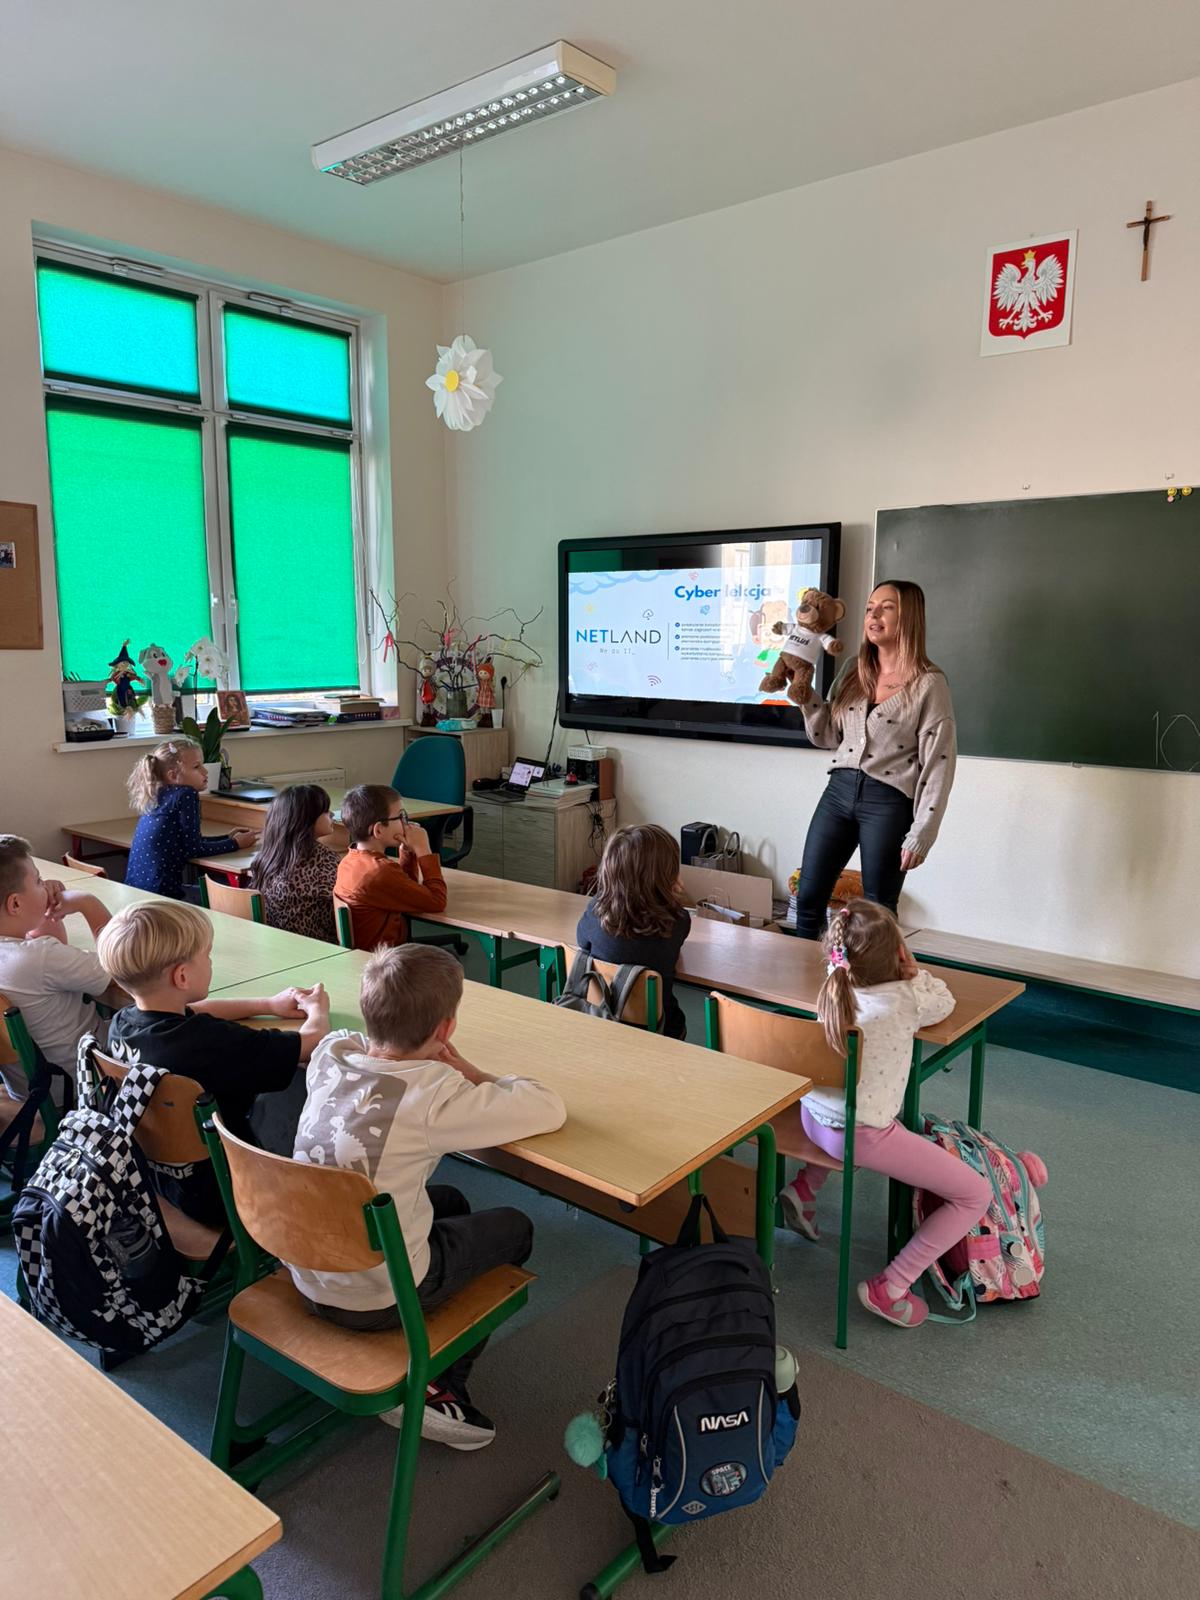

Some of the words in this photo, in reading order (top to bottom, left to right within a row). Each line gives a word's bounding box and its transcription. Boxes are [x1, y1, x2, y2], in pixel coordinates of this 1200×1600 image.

[674, 585, 721, 601] Cyber
[725, 584, 771, 601] lekcja
[575, 629, 662, 644] NETLAND
[701, 1410, 749, 1432] NASA
